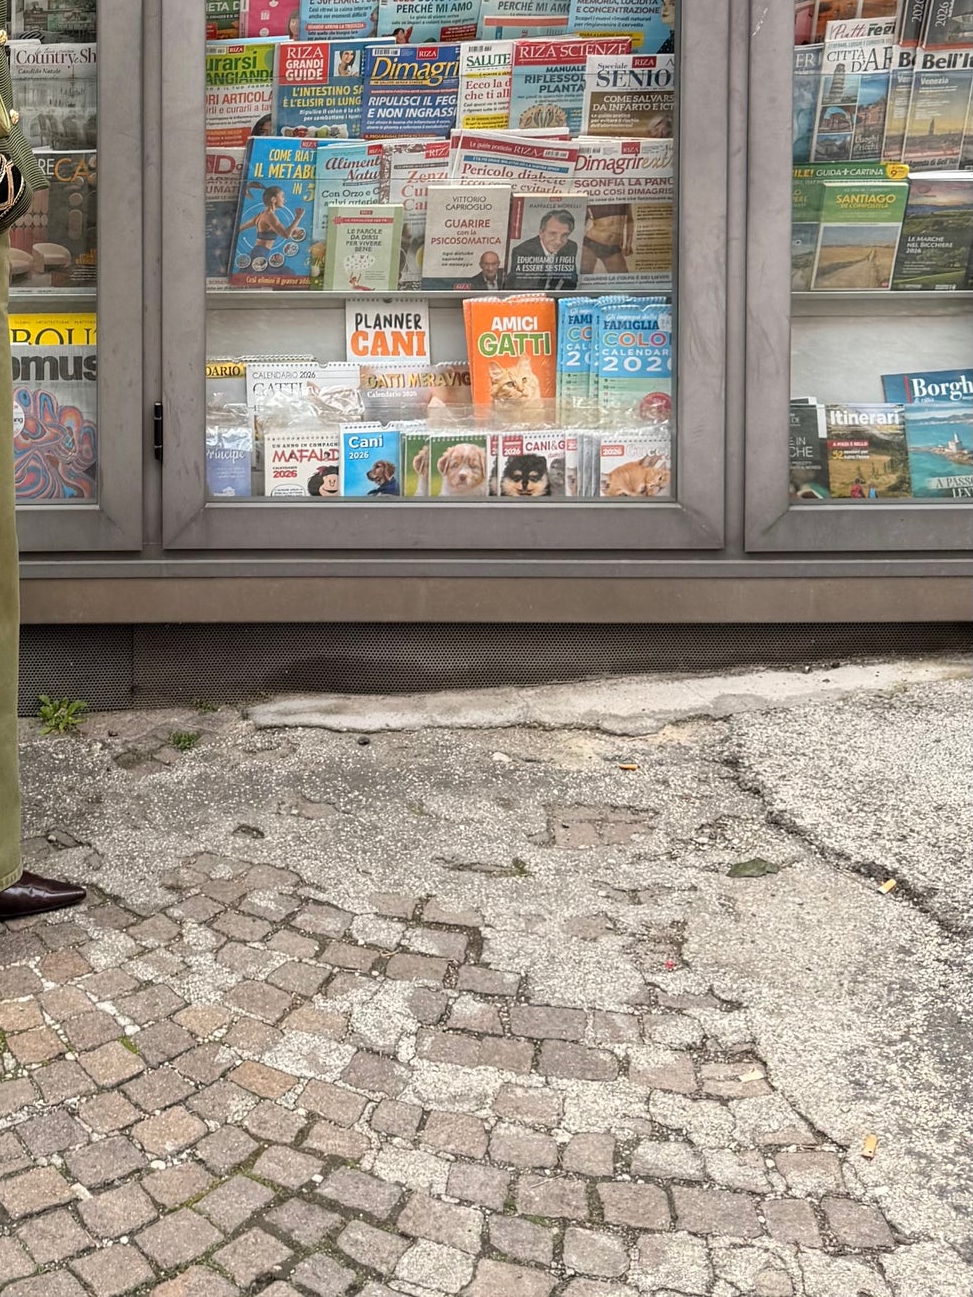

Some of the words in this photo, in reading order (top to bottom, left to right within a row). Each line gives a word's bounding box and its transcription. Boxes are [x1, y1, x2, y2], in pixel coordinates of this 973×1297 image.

[583, 5, 659, 15] CONCENTRAZIONE
[287, 46, 324, 58] RIZA
[560, 41, 628, 58] SCIENZE
[826, 46, 866, 63] CITTÀ
[285, 58, 324, 70] GRANDI
[634, 57, 655, 67] RIZA
[285, 68, 324, 81] GUIDE
[920, 76, 949, 86] Venezia
[292, 86, 346, 100] L'INTESTINO
[368, 95, 421, 107] RIPULISCI
[609, 102, 651, 112] INFARTO
[379, 106, 404, 118] NON
[462, 164, 515, 180] Pericolo
[574, 177, 624, 188] SGONFIA
[452, 196, 486, 204] VITTORIO
[835, 193, 896, 205] SANTIAGO
[445, 203, 492, 212] CAPRIOGLIO
[444, 219, 491, 228] GUARIRE
[430, 236, 502, 246] PSICOSOMATICA
[919, 235, 945, 243] MARCHE
[356, 312, 423, 332] PLANNER
[491, 316, 539, 332] AMICI
[603, 315, 661, 331] FAMIGLIA
[350, 331, 427, 357] CANI
[478, 331, 552, 358] GATTI
[252, 370, 297, 379] CALENDARIO
[298, 369, 316, 379] 2026
[830, 410, 900, 426] Itinerari
[348, 435, 384, 450] Cani
[348, 451, 370, 461] 2026
[273, 469, 298, 479] 2026
